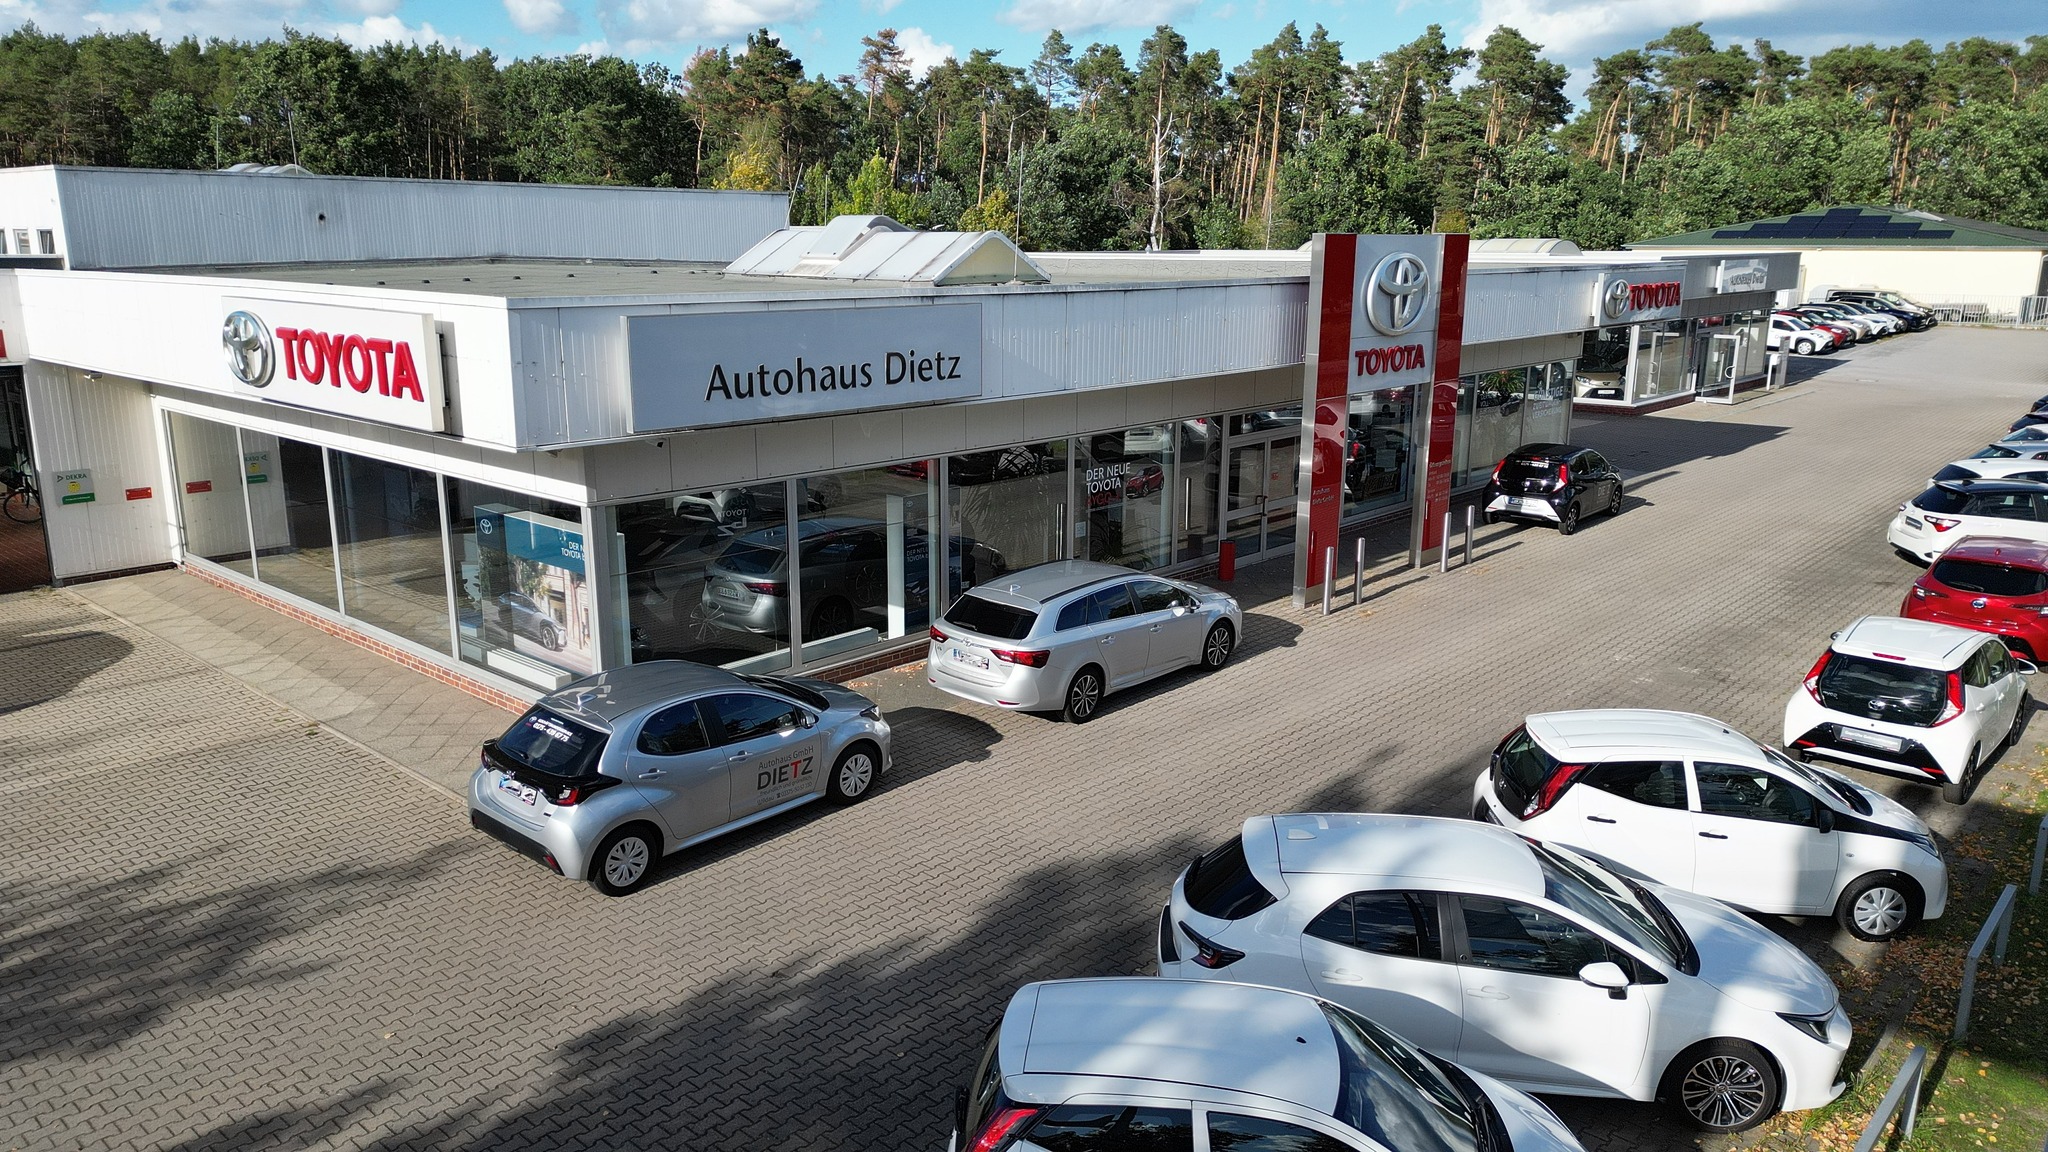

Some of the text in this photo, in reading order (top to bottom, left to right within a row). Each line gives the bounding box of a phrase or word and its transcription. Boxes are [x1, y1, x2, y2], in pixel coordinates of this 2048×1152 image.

[1627, 281, 1681, 311] TOYOTA
[276, 327, 424, 402] TOYOTA
[1354, 344, 1426, 376] TOYOTA
[704, 349, 962, 402] Autohaus Dietz
[65, 473, 87, 481] DEKRA
[1086, 462, 1131, 481] DER NEUE
[1086, 477, 1122, 494] TOYOTA
[561, 547, 582, 560] TOYOTA
[569, 541, 579, 550] DER
[759, 745, 814, 770] Autohaus GmbH
[757, 756, 814, 791] DIETZ
